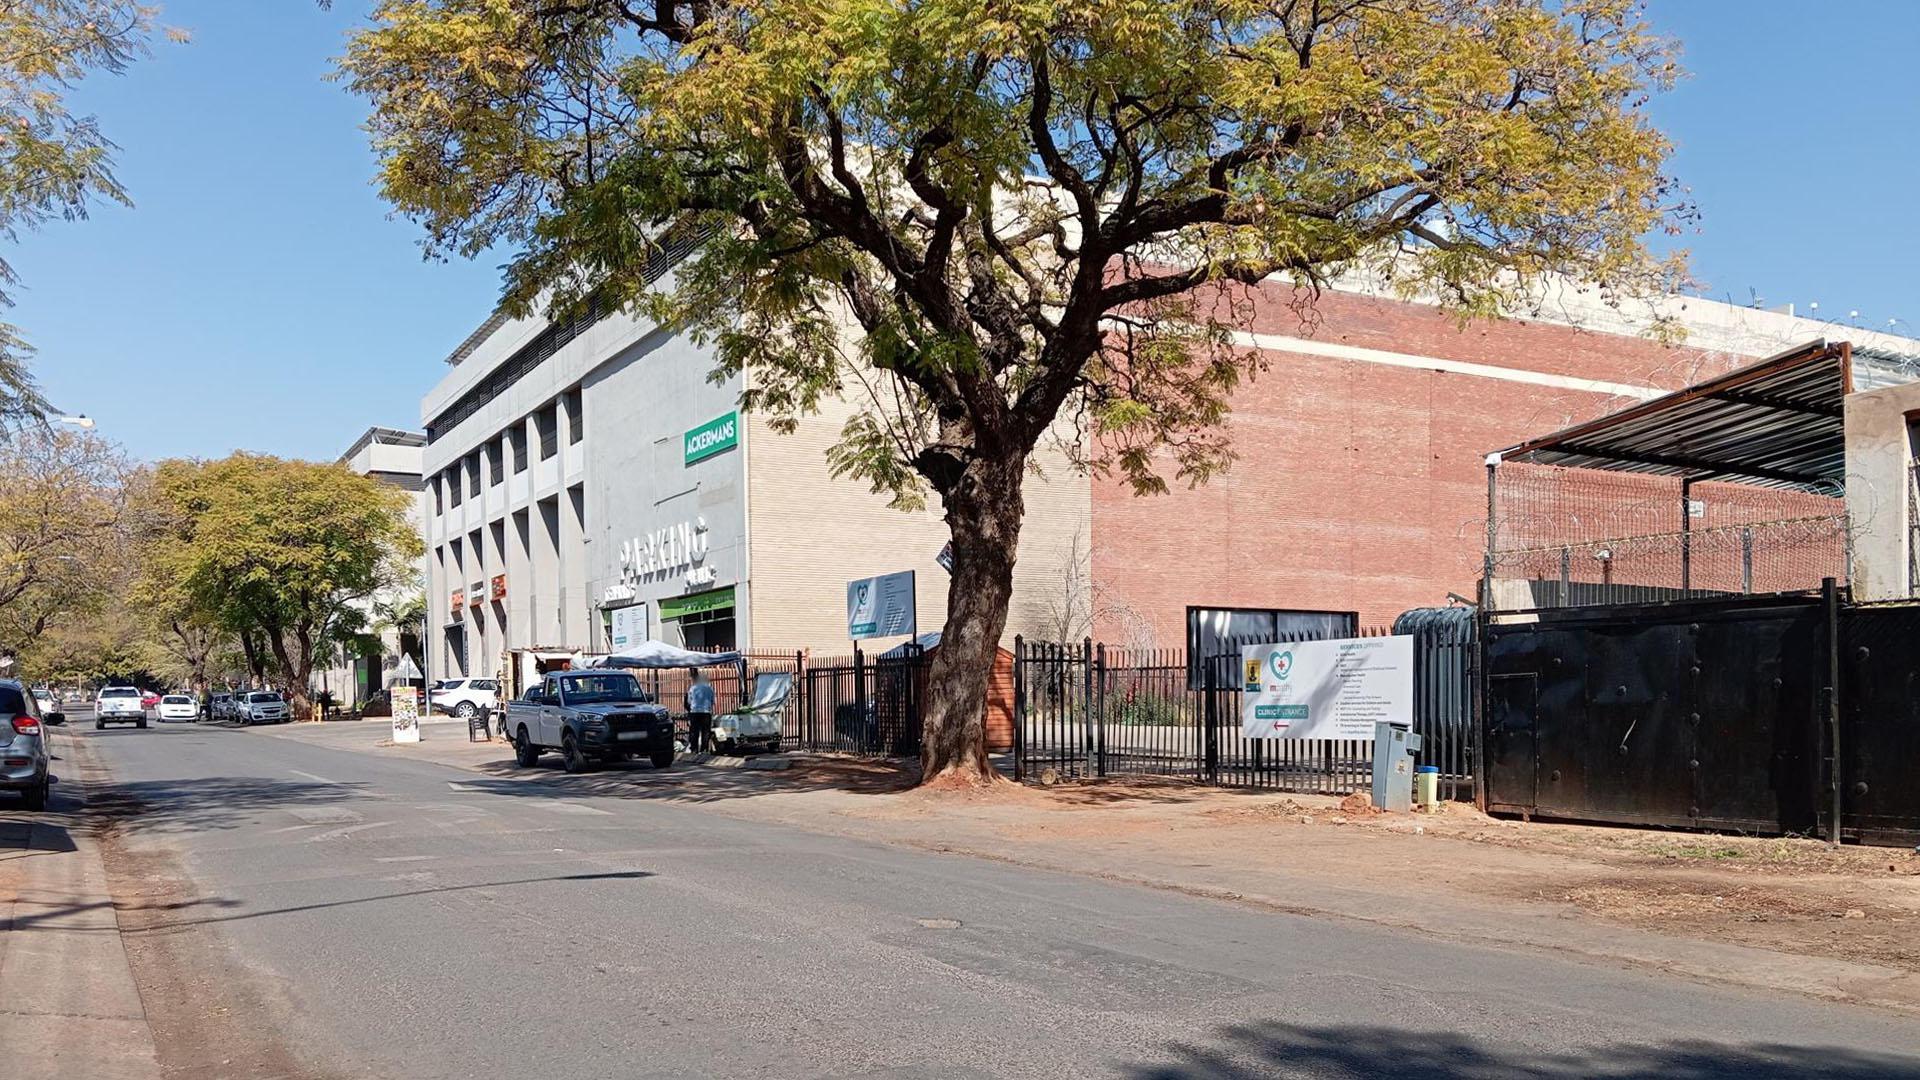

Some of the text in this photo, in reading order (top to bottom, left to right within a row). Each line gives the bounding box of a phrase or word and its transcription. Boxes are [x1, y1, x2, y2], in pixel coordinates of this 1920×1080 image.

[686, 420, 735, 455] ACKERMANS
[618, 516, 708, 582] PARKING
[1257, 708, 1278, 716] CLINIC
